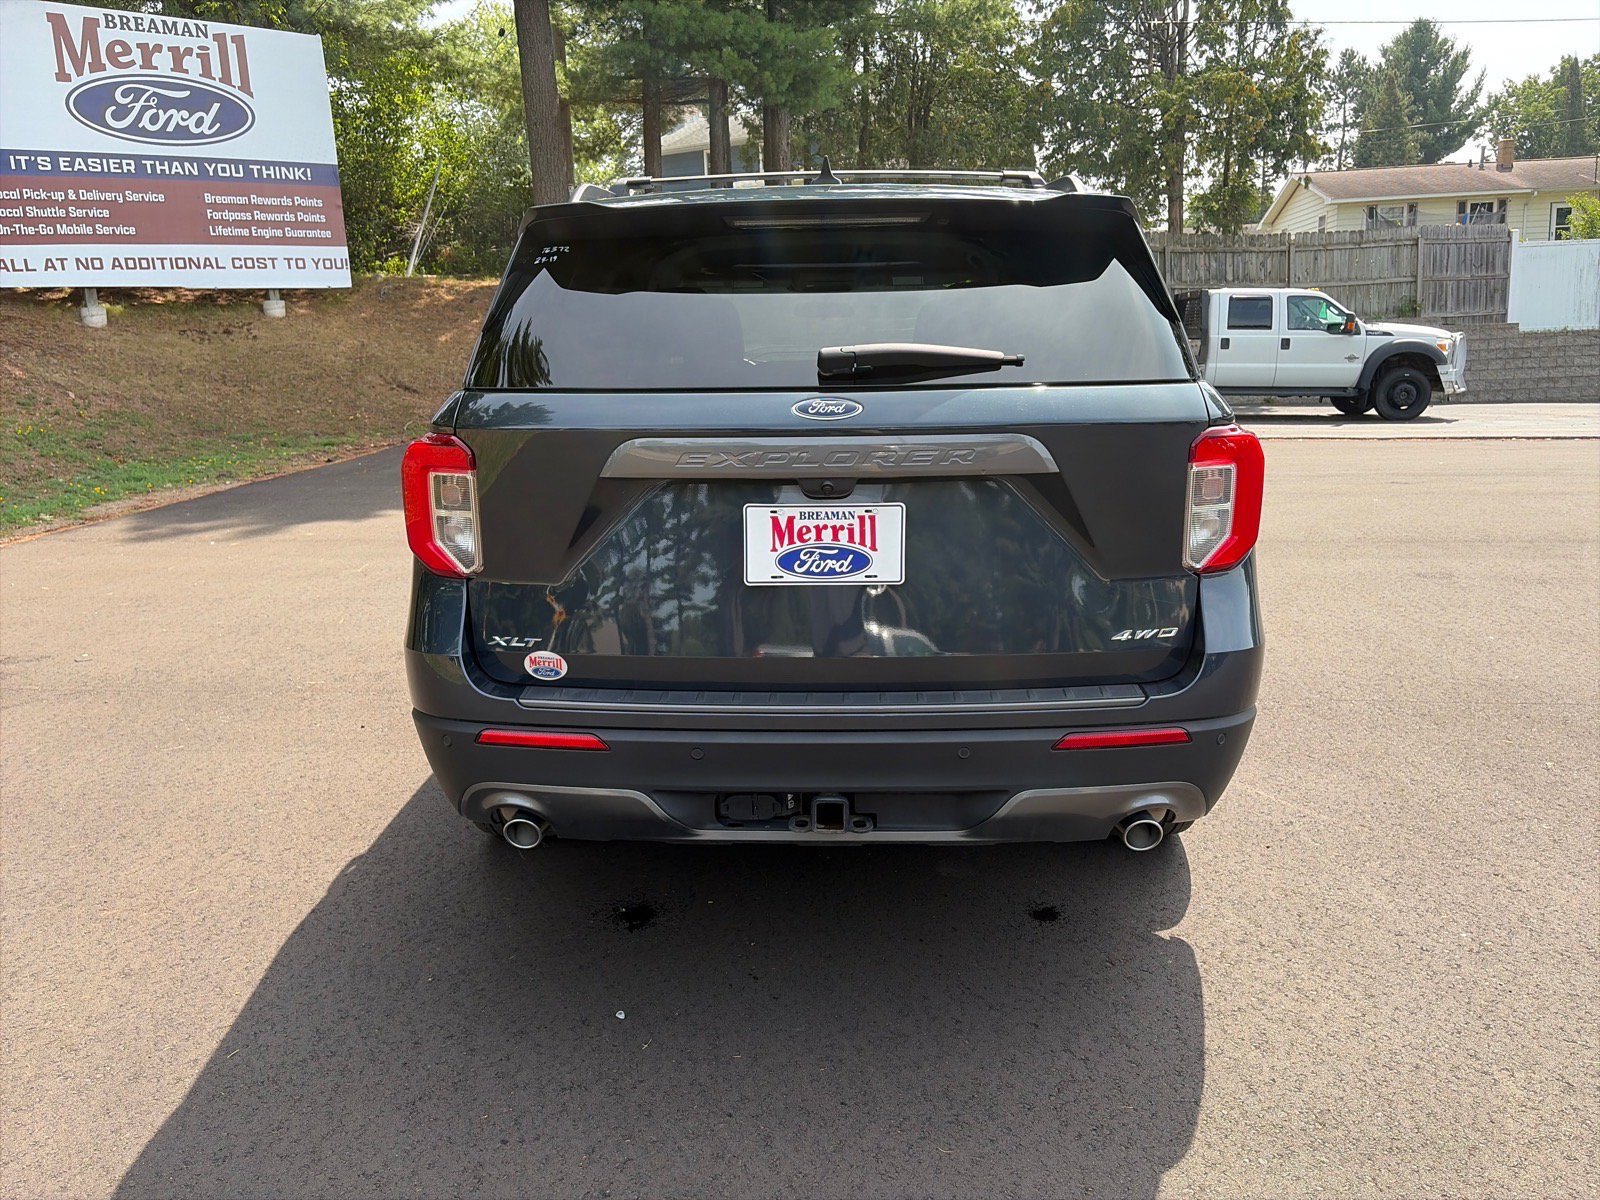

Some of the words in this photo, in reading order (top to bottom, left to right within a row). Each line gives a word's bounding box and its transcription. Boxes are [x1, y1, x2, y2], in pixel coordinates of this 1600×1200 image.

[102, 13, 209, 39] BREAMAN
[46, 12, 254, 99] Merrill
[105, 83, 220, 135] Ford
[9, 155, 52, 171] IT'S
[58, 157, 136, 174] EASIER
[142, 160, 199, 175] THAN
[204, 162, 244, 178] YOU
[249, 165, 312, 181] THINK!
[0, 188, 20, 200] cal
[22, 188, 65, 202] Pick-up
[68, 189, 77, 200] &
[79, 189, 124, 203] Delivery
[125, 190, 165, 202] Service
[204, 192, 249, 205] Breaman
[250, 194, 292, 206] Rewards
[294, 196, 323, 208] Points
[0, 206, 23, 218] ocal
[26, 206, 66, 218] Shuttle
[68, 206, 110, 218] Service
[206, 209, 252, 222] Fordpass
[253, 210, 295, 222] Rewards
[297, 212, 326, 223] Points
[56, 223, 93, 235] Mobile
[95, 224, 136, 235] Service
[209, 225, 249, 237] Lifetime
[251, 226, 283, 239] Engine
[284, 227, 332, 238] Guarantee
[0, 258, 37, 273] ALL
[44, 258, 68, 271] AT
[75, 257, 104, 271] NO
[111, 257, 226, 270] ADDITIONAL
[231, 257, 278, 270] COST
[283, 257, 306, 270] TO
[311, 257, 349, 270] YOU!
[808, 399, 846, 414] Ford
[675, 448, 978, 468] EXPLORER
[798, 510, 856, 521] BREAMAN
[770, 514, 878, 552] Merrill
[793, 548, 853, 574] Ford
[487, 635, 543, 648] XLT
[1110, 627, 1179, 641] 4WD
[529, 655, 563, 671] Merrill
[537, 667, 556, 676] Ford
